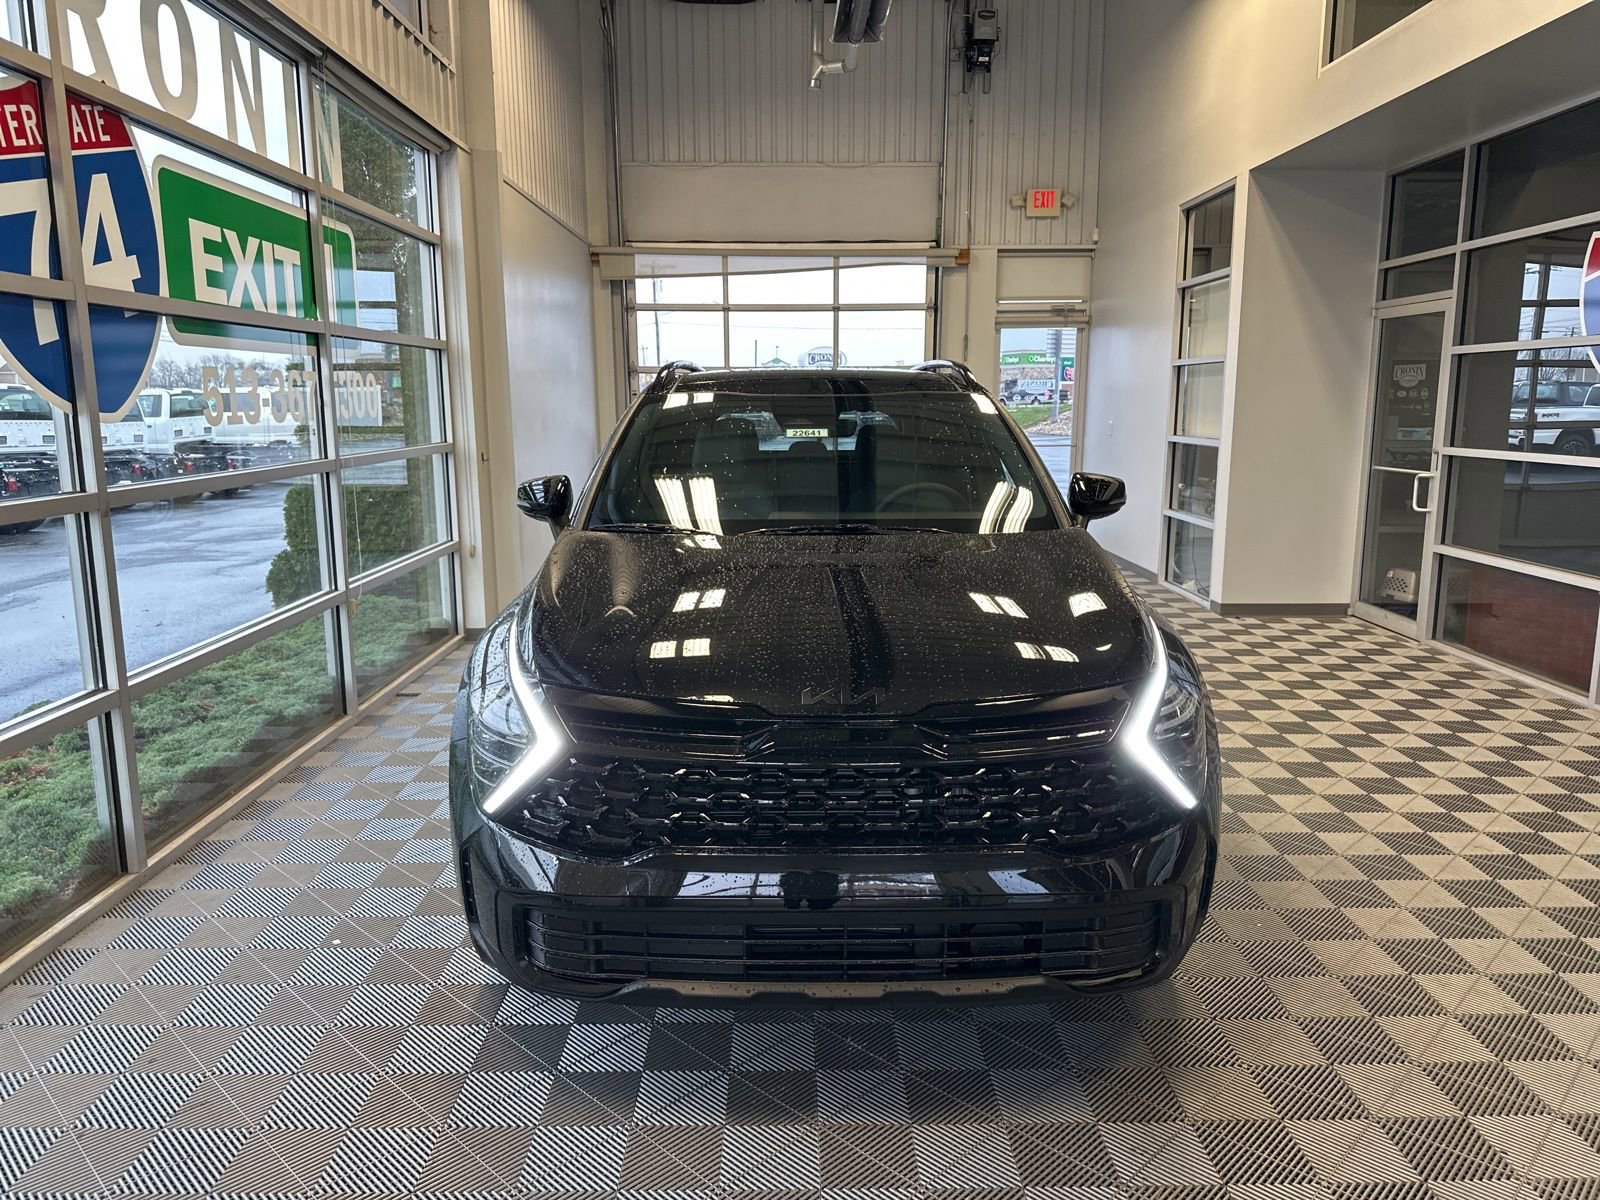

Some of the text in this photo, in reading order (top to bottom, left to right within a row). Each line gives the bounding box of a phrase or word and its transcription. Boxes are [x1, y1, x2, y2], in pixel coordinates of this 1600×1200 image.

[1033, 190, 1056, 208] EXIT
[0, 172, 142, 346] 74
[188, 217, 301, 318] EXIT
[809, 353, 841, 364] CRON
